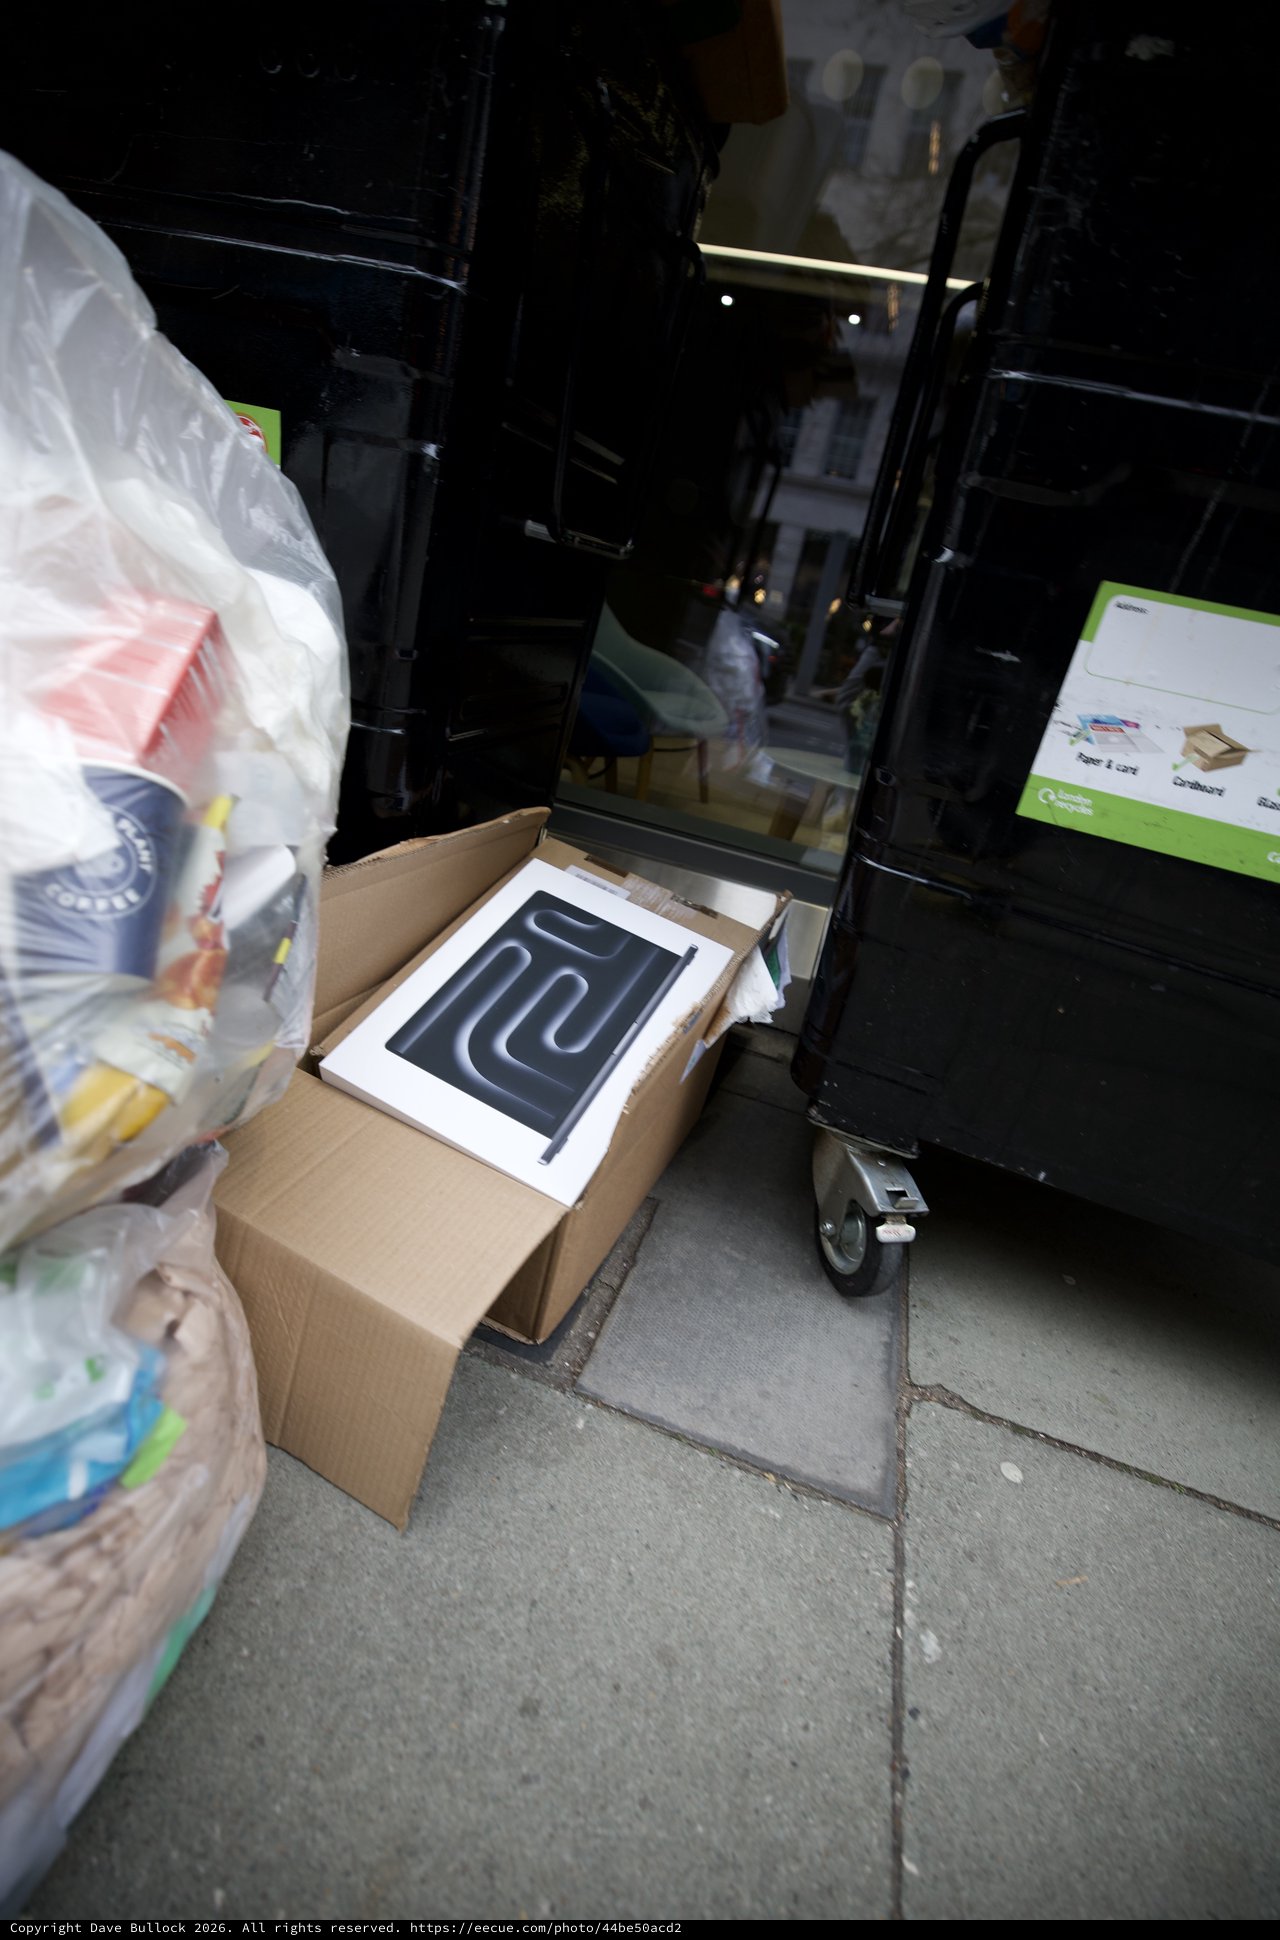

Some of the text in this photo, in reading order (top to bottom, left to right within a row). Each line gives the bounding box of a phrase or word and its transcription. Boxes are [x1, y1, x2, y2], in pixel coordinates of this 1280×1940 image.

[1076, 752, 1140, 776] Paper & card
[1172, 776, 1226, 797] Cardboard
[45, 883, 141, 911] COFFEE
